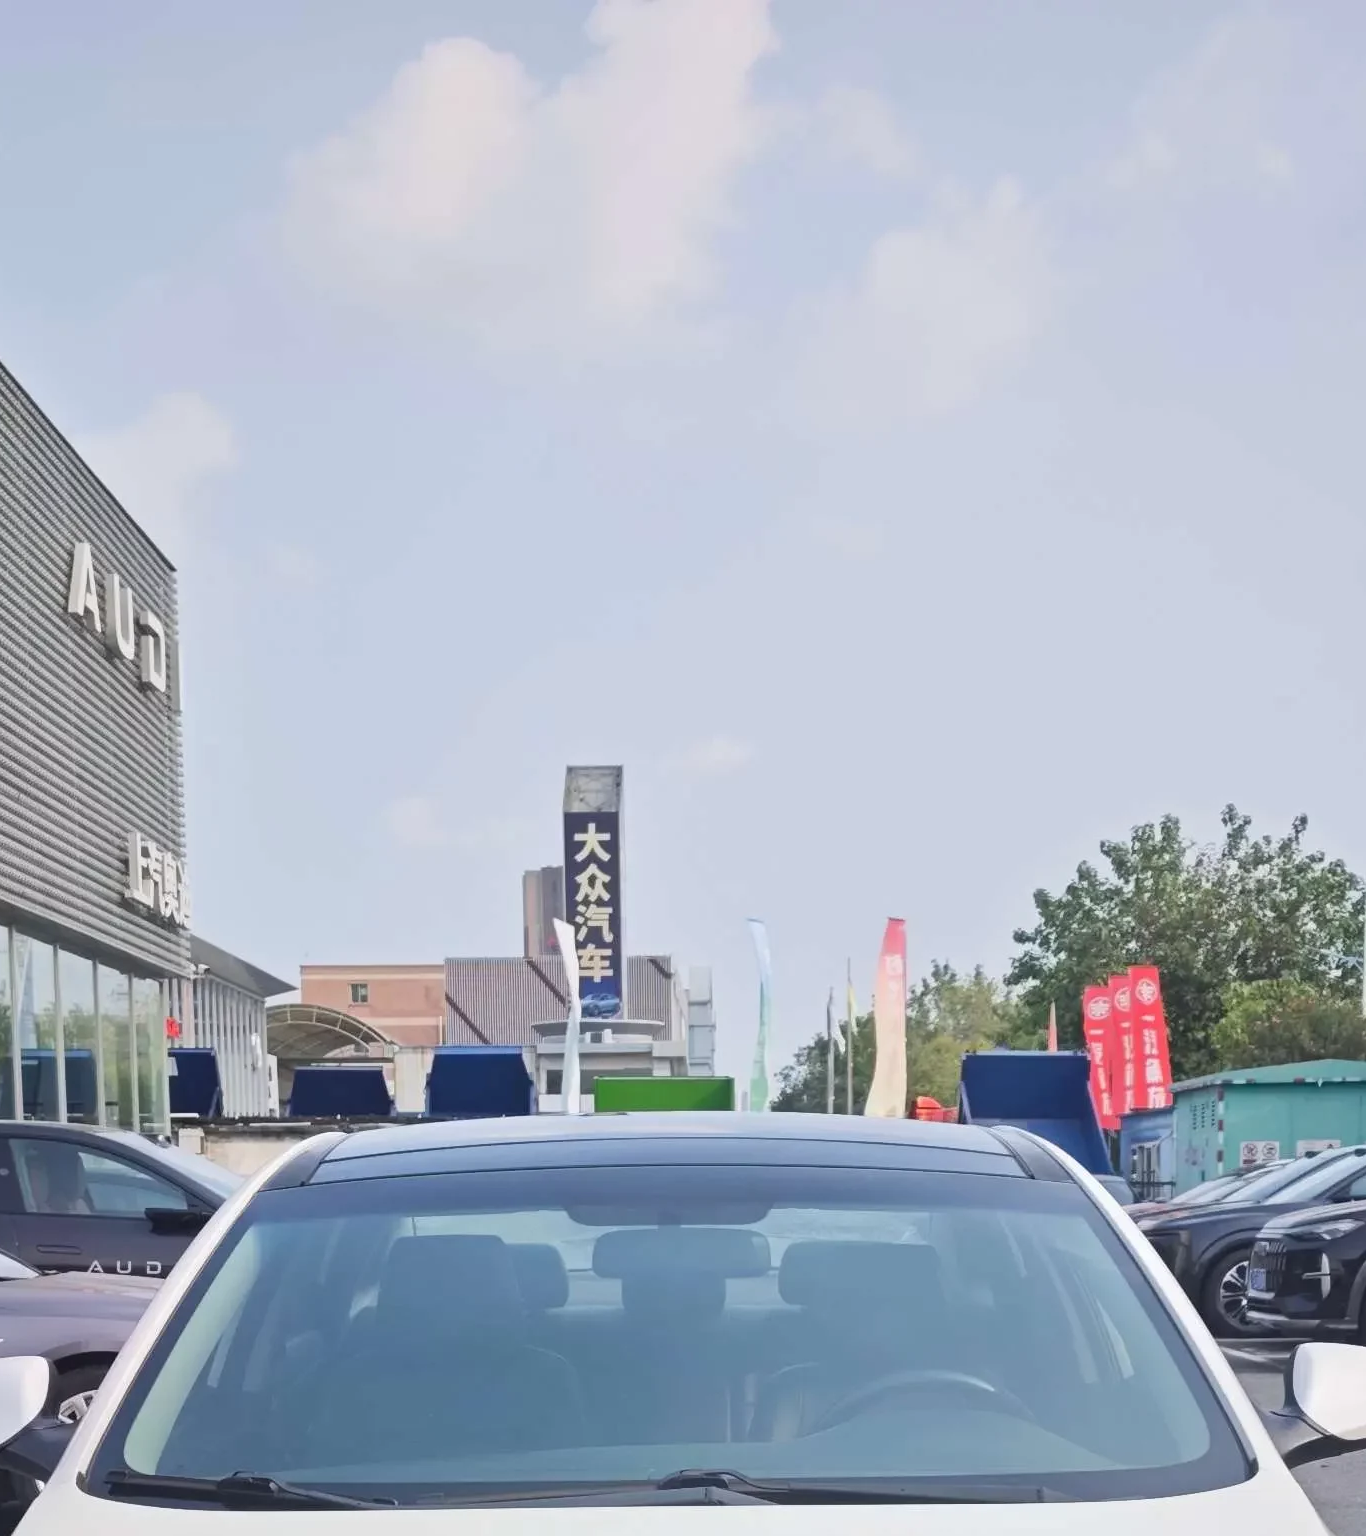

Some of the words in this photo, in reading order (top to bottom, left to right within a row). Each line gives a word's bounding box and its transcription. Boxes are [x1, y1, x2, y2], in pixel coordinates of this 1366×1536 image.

[573, 823, 614, 983] 大众汽车
[88, 1260, 162, 1275] AUD
